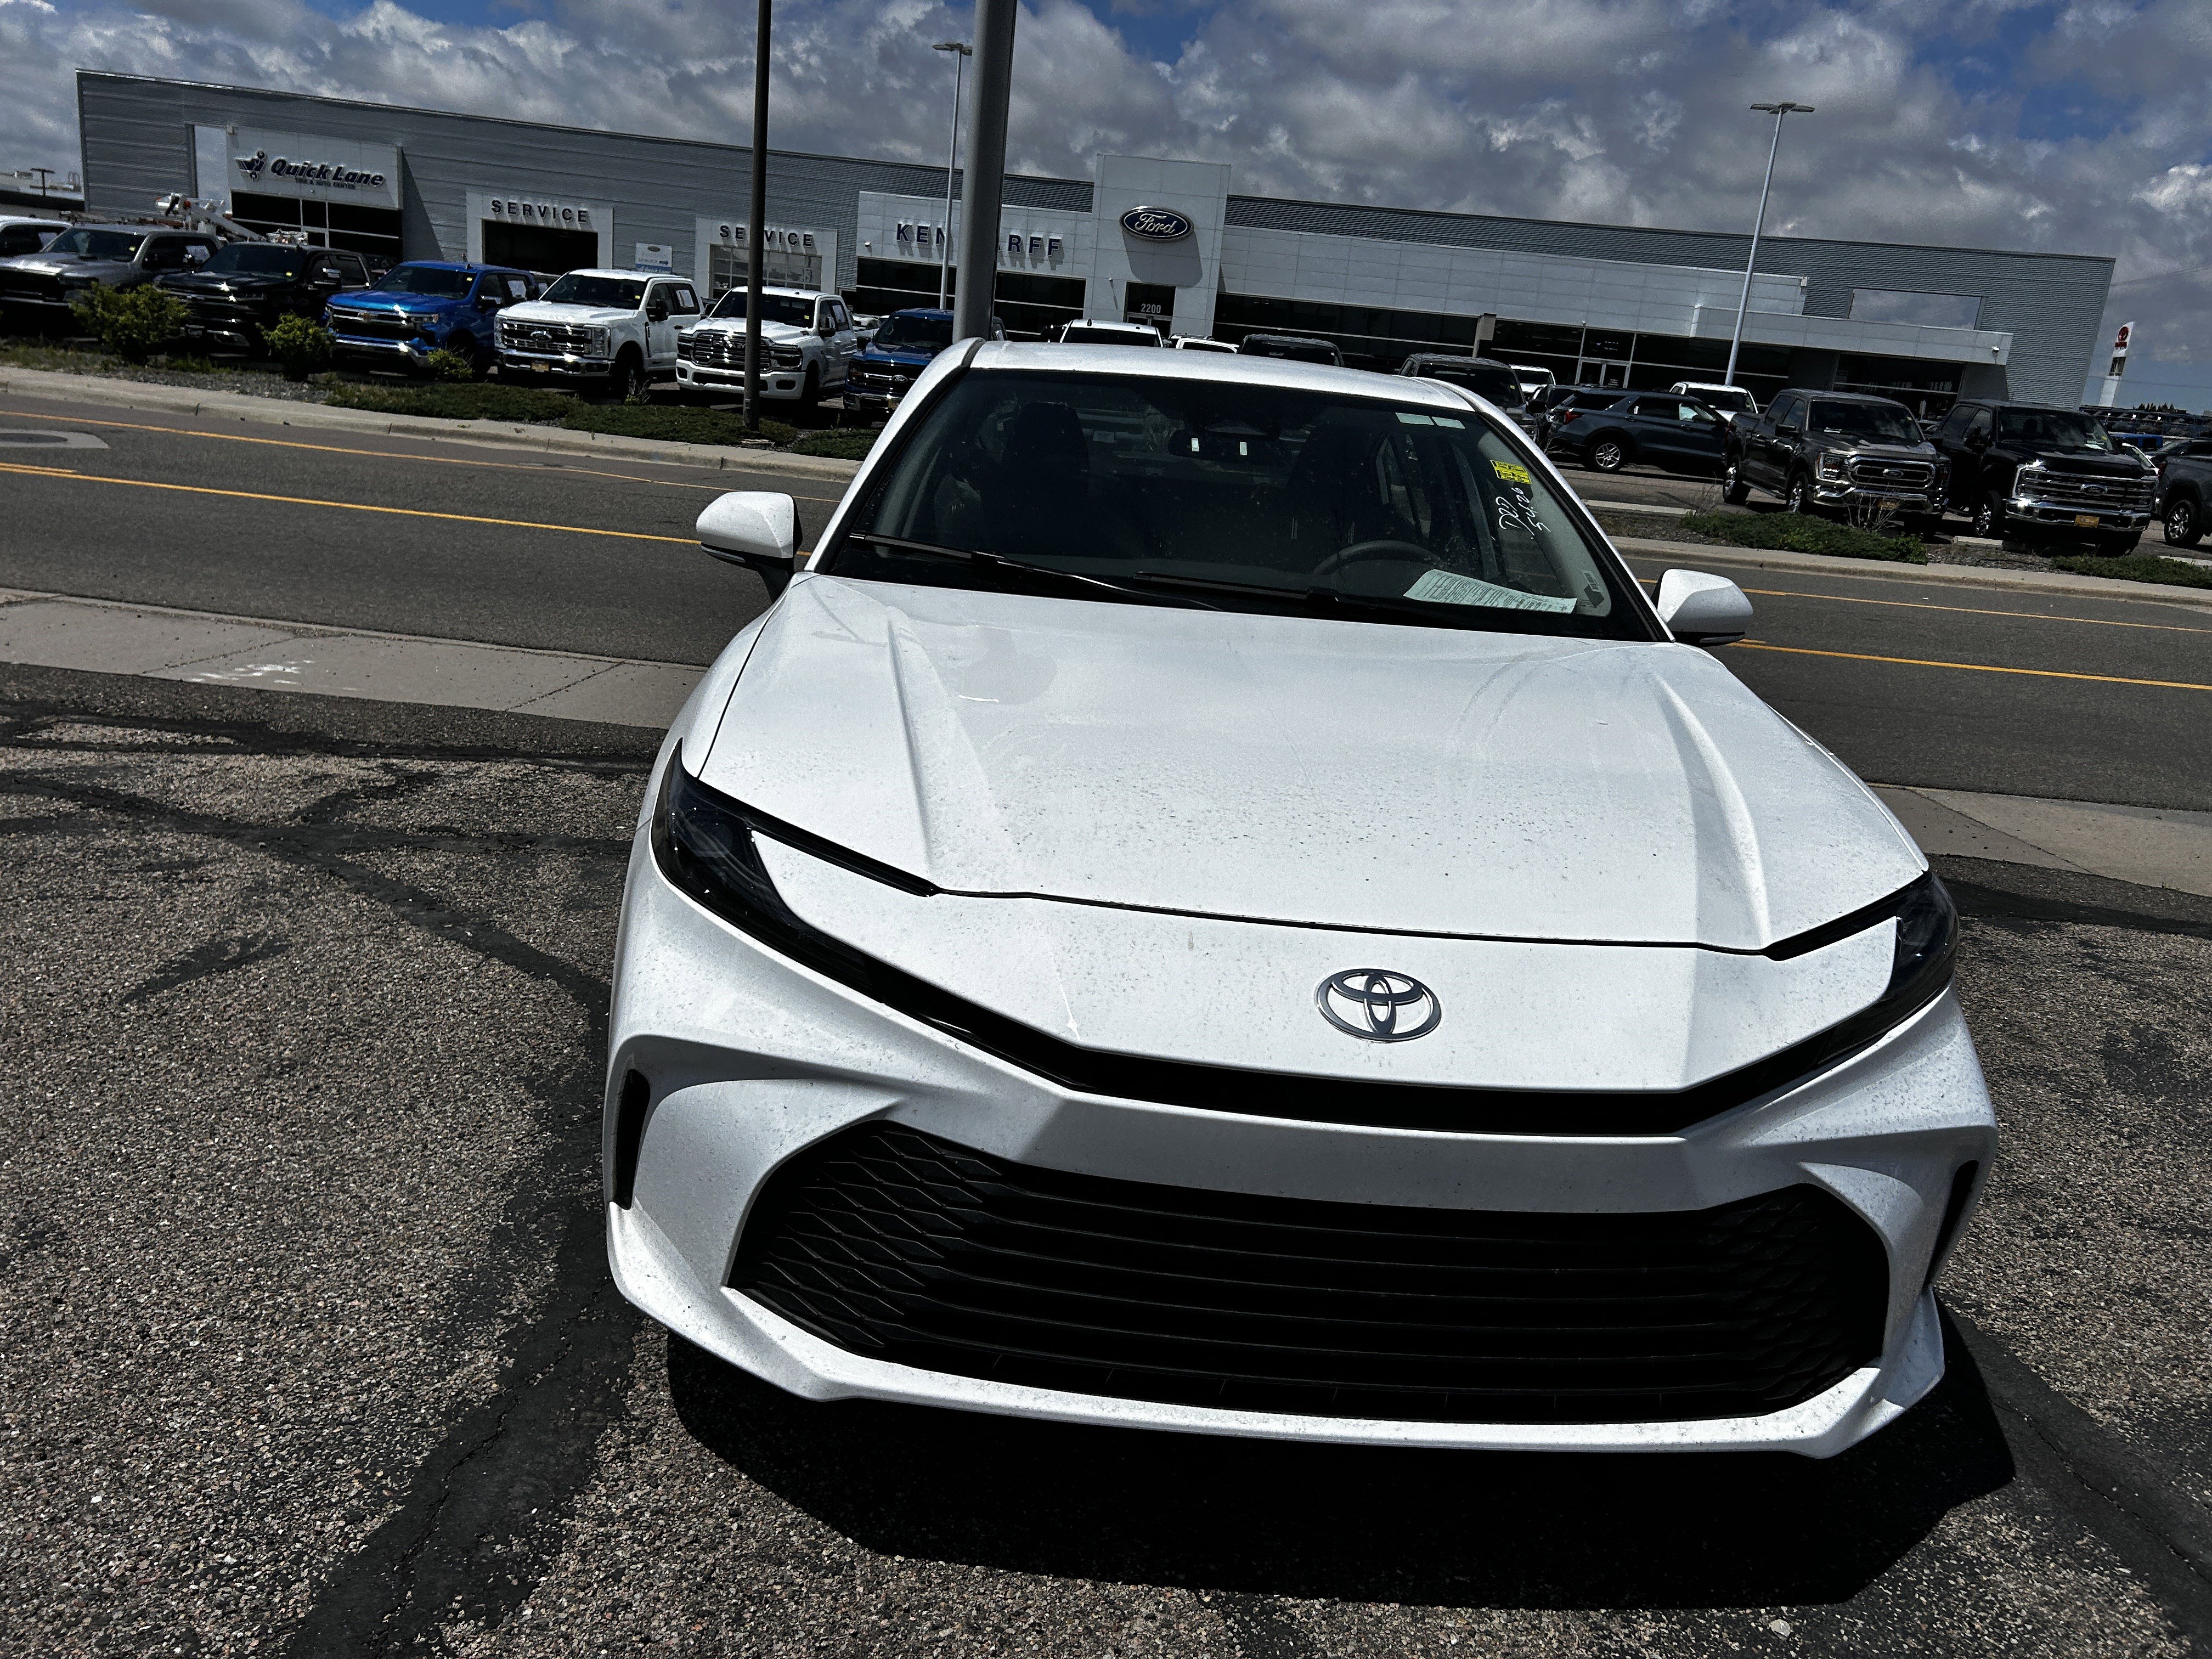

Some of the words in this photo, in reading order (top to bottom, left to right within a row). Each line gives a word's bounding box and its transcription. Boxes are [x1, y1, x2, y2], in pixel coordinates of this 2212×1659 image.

[270, 158, 330, 179] Quick
[332, 165, 384, 185] Lane
[491, 200, 588, 222] SERVICE
[1135, 213, 1177, 234] Ford
[720, 225, 812, 246] SEVICE
[1141, 303, 1161, 314] 2200
